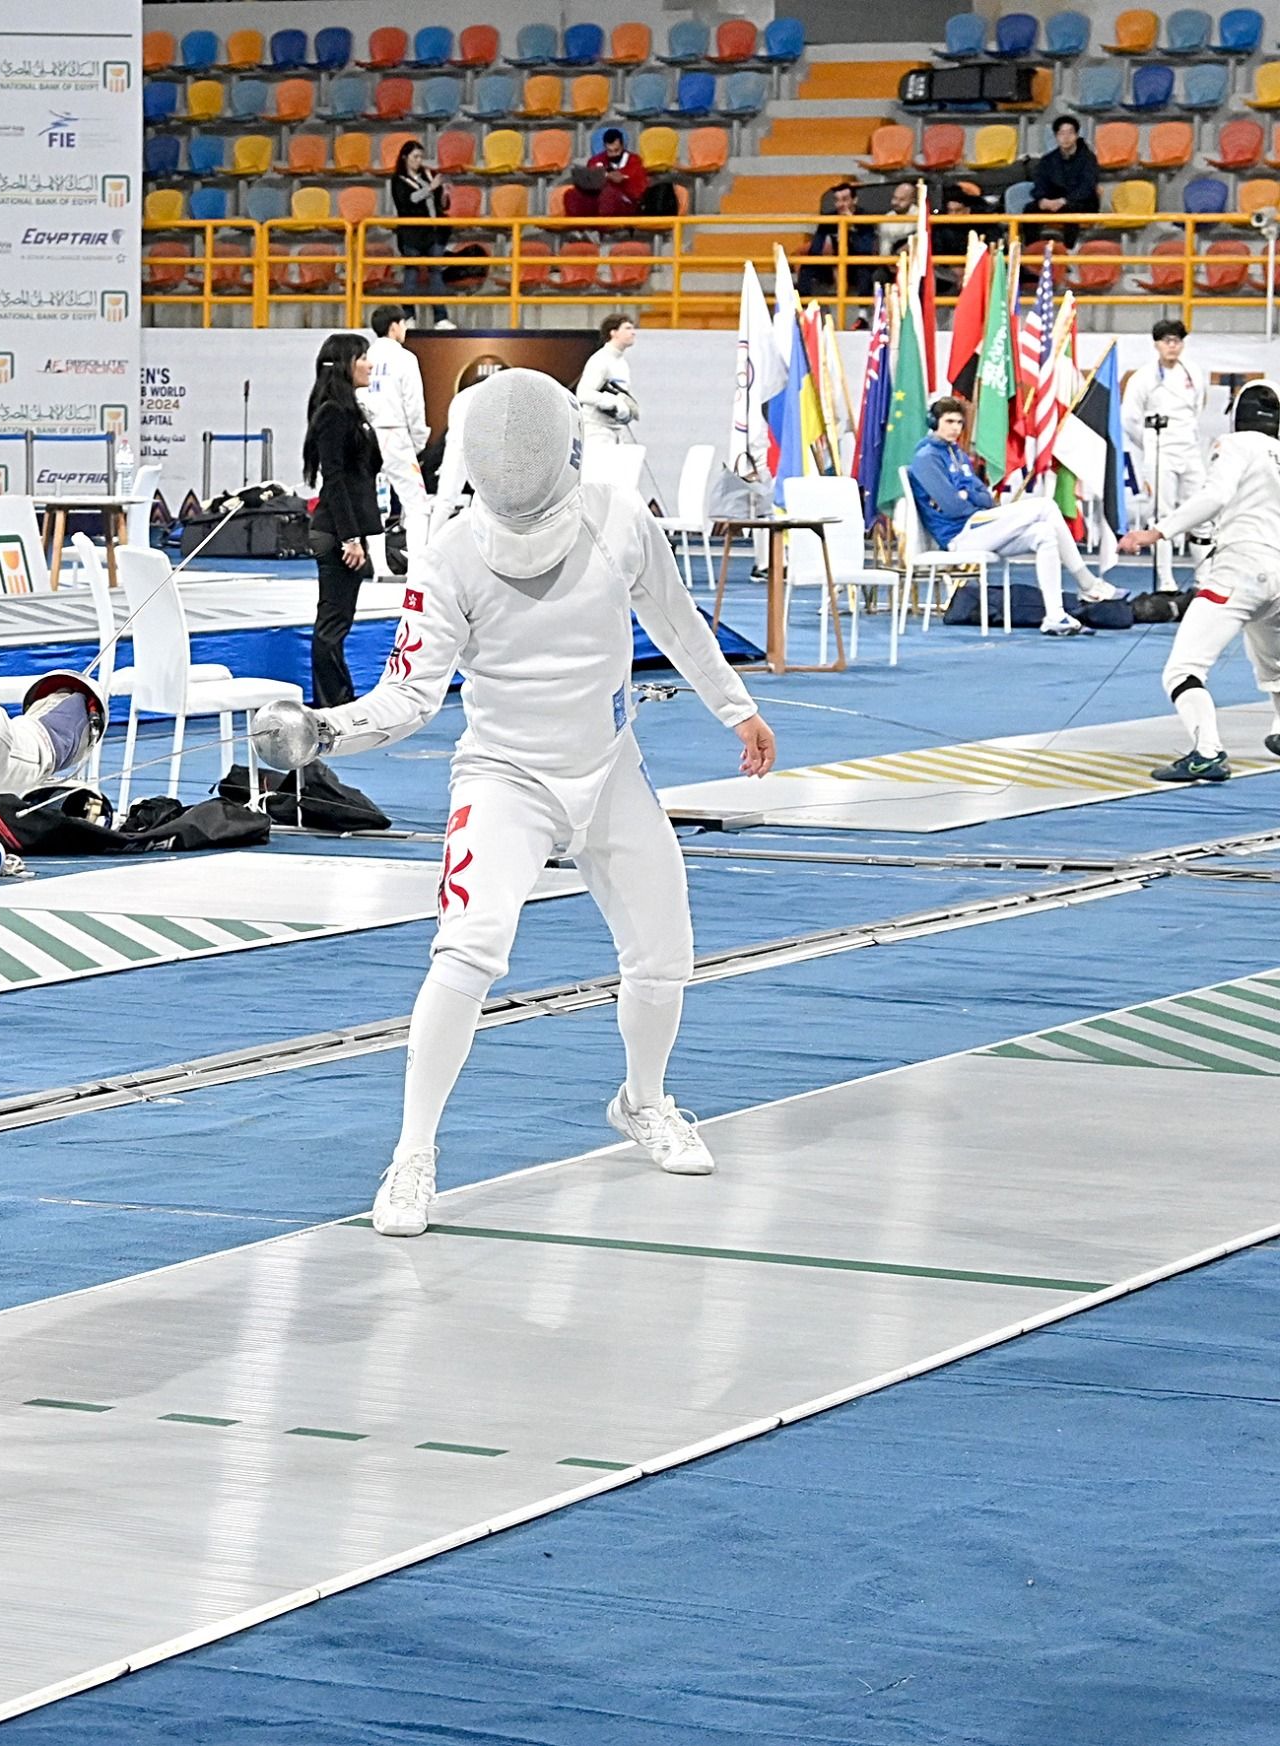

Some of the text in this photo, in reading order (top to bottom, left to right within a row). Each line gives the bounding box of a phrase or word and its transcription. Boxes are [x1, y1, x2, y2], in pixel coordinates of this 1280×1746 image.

[49, 131, 76, 148] FIE
[21, 228, 109, 245] EGYPTAIR
[59, 313, 70, 321] OF
[72, 313, 97, 321] EGYPT
[150, 386, 186, 397] WORLD
[146, 399, 181, 410] 2024
